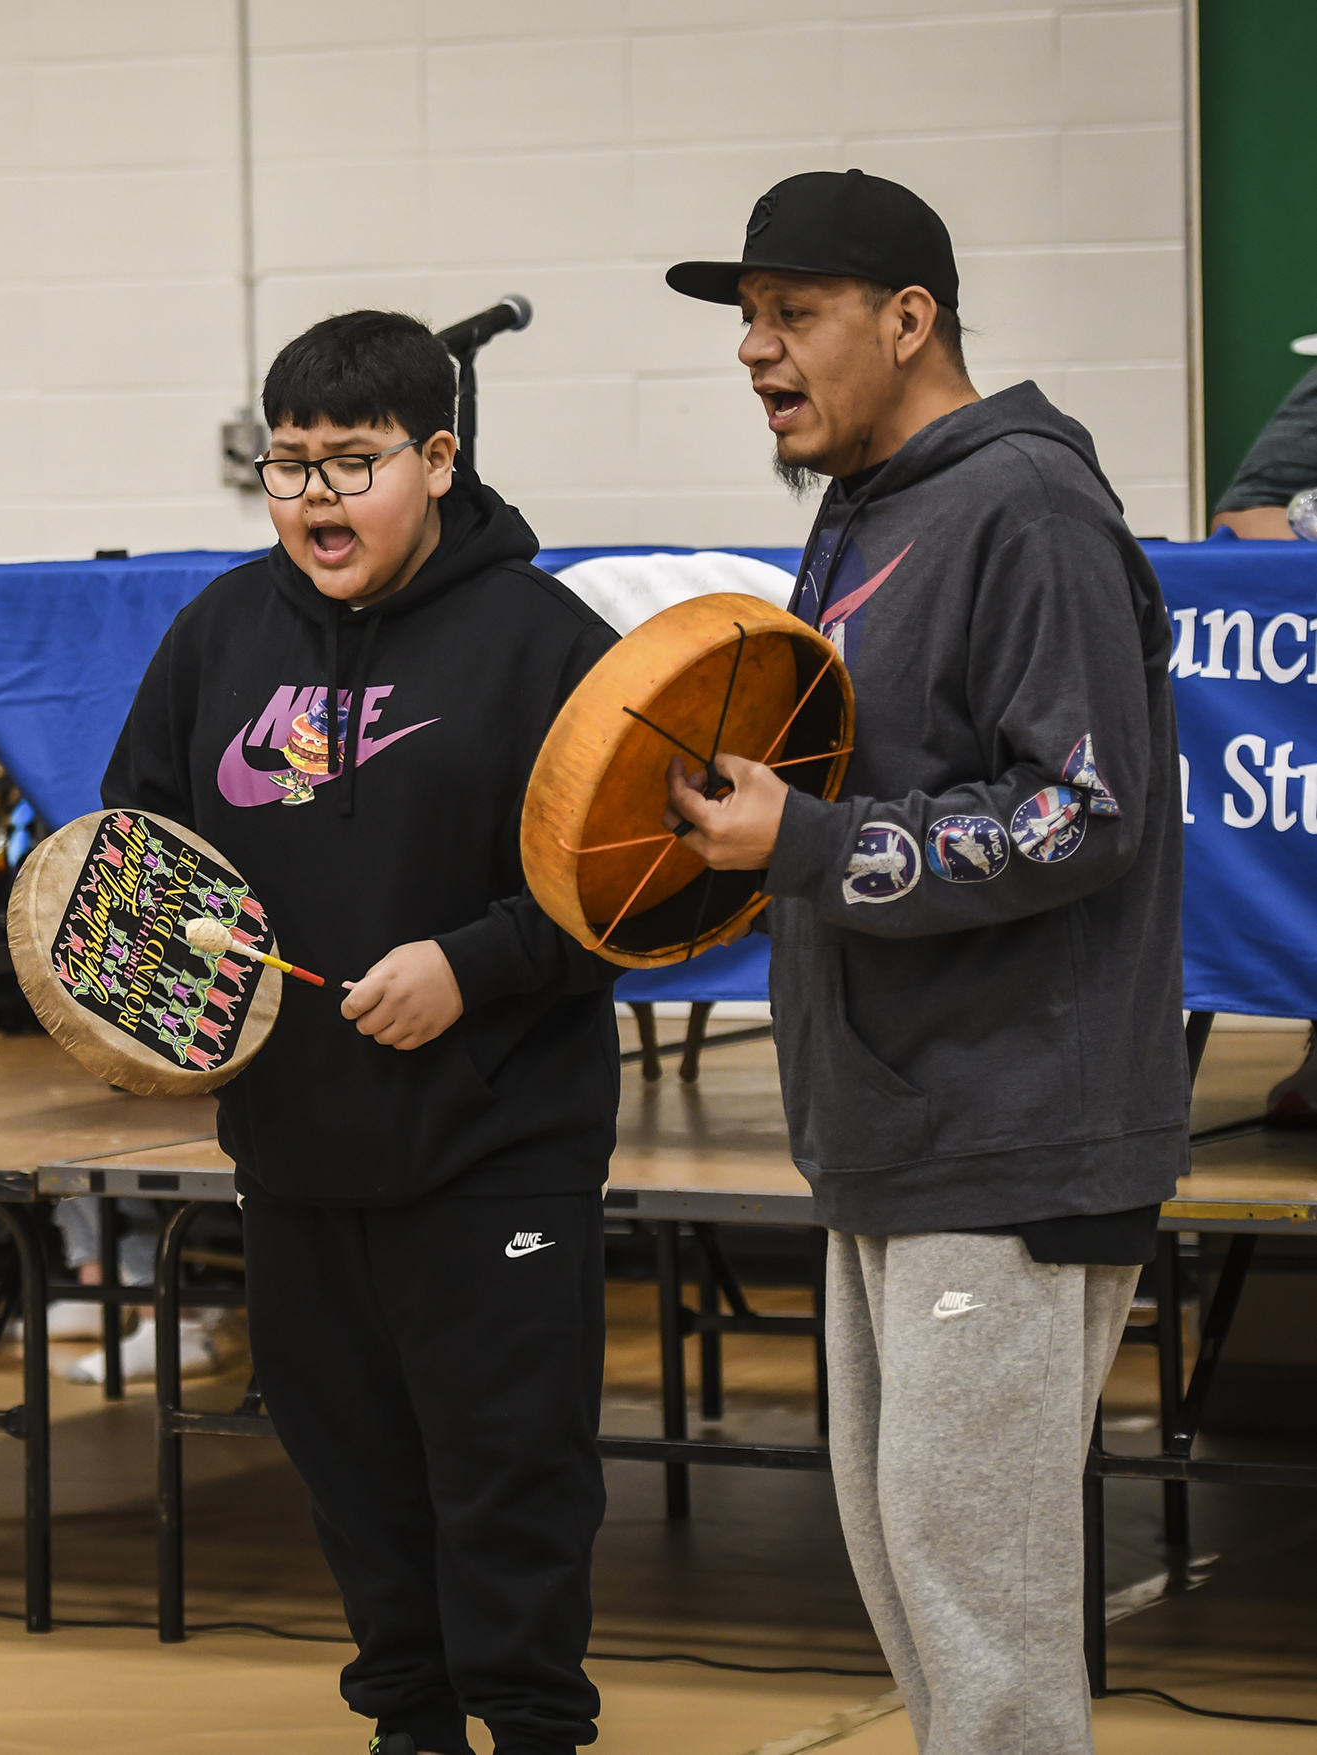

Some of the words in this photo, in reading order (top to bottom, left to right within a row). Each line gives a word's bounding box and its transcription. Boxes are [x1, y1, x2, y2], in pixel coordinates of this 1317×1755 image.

[988, 829, 1004, 861] NASA
[68, 881, 113, 1004] Jerrilane
[99, 822, 147, 917] Lincoln
[117, 939, 165, 1033] ROUND
[152, 847, 201, 940] DANCE
[124, 881, 166, 979] BIRTHDAY
[512, 1231, 543, 1249] NIKE
[940, 1291, 973, 1309] NIKE
